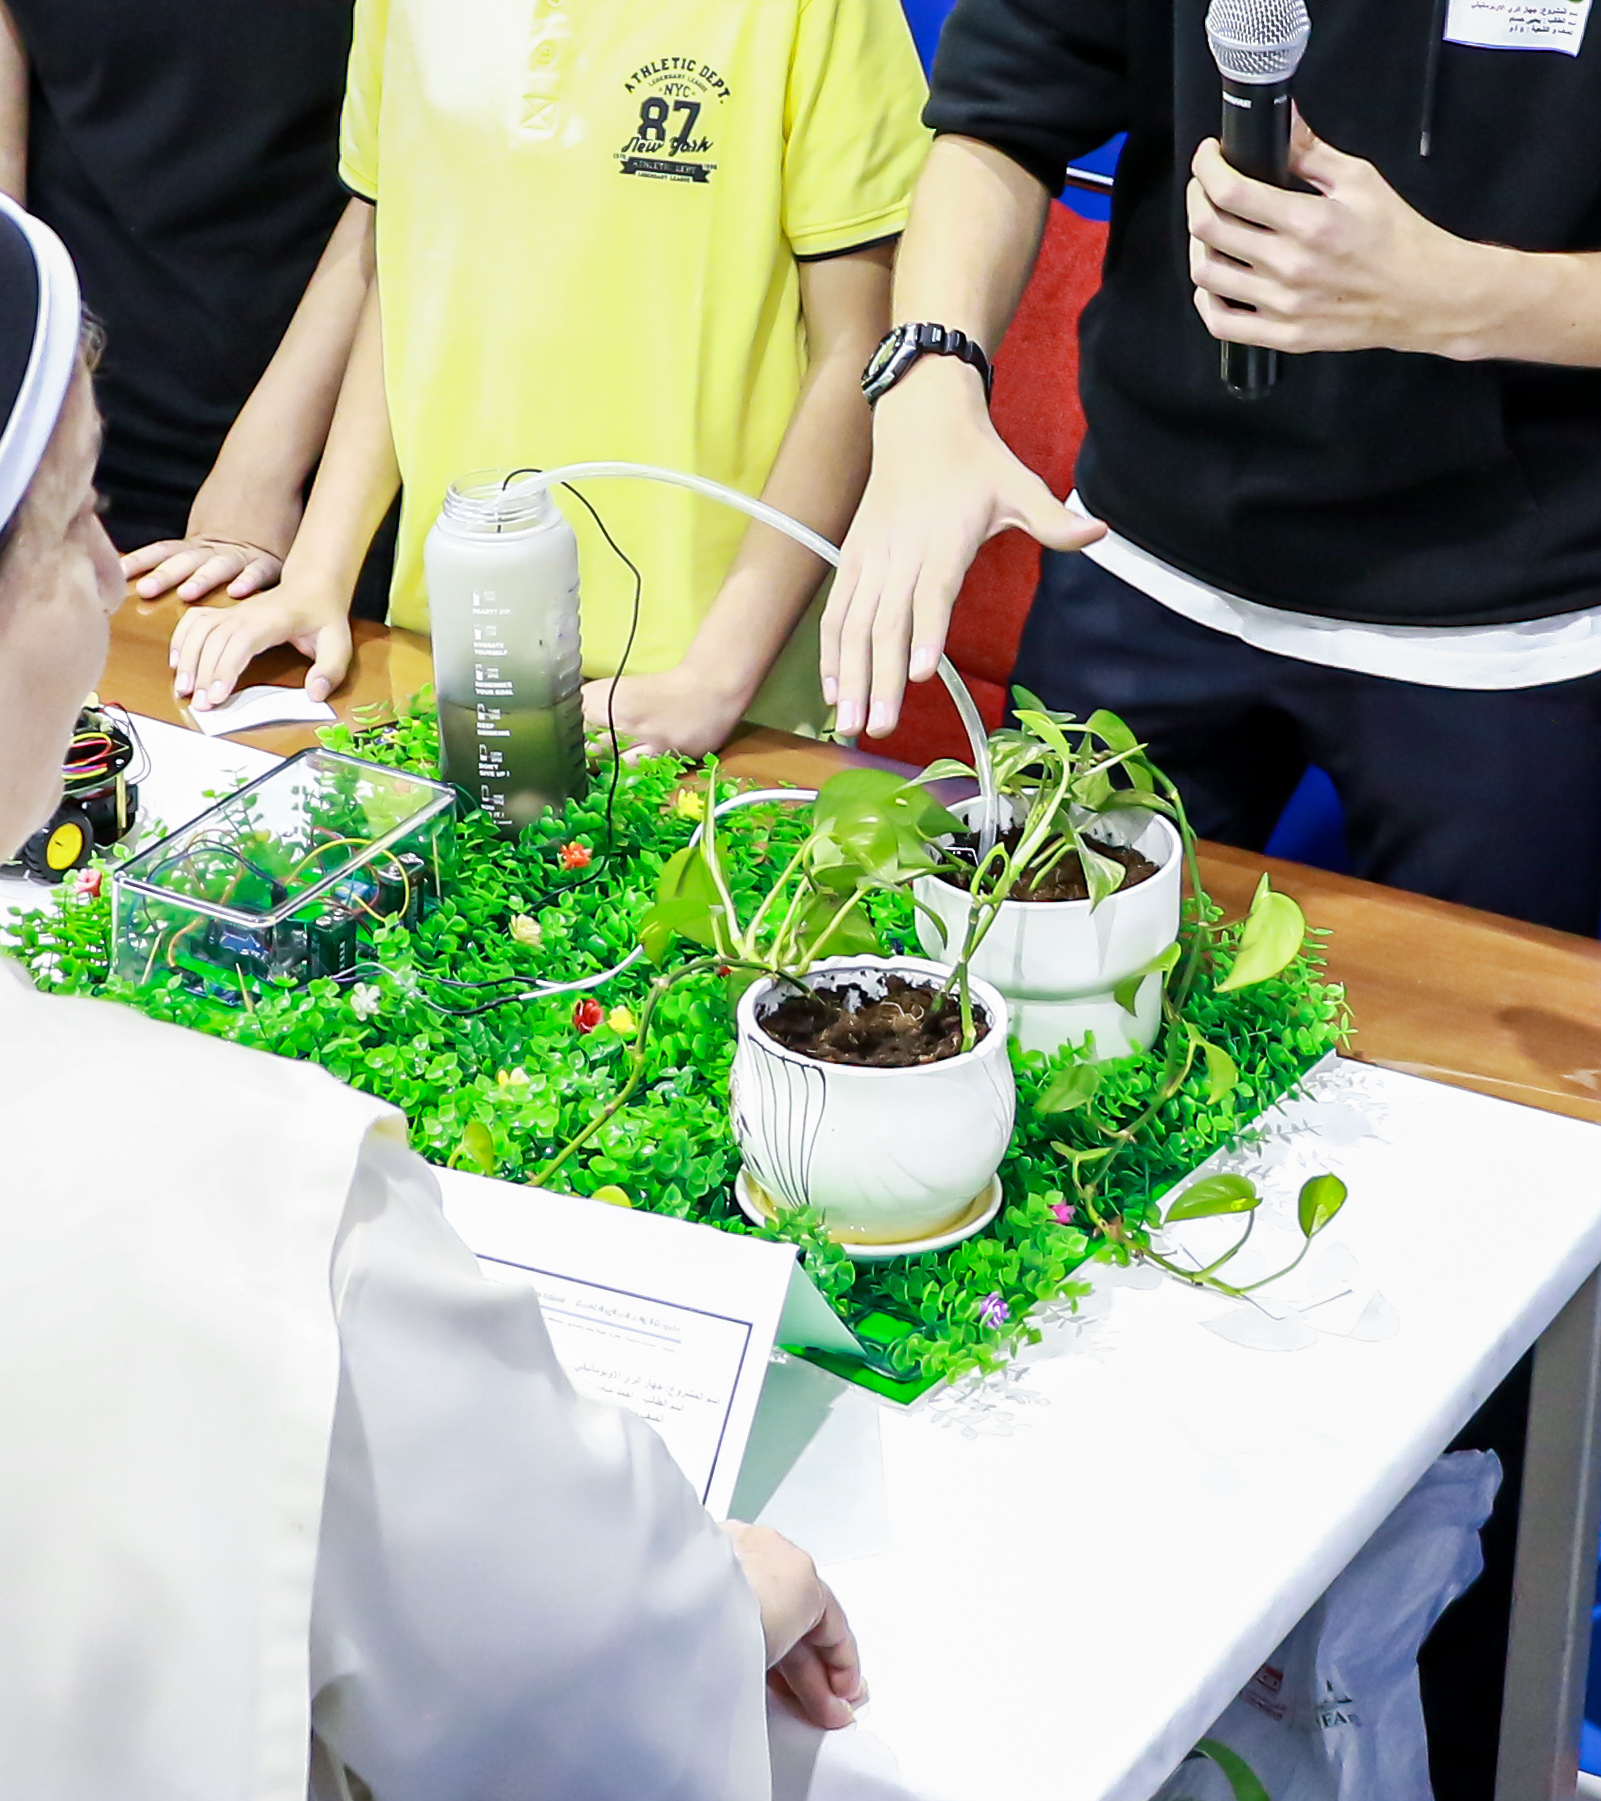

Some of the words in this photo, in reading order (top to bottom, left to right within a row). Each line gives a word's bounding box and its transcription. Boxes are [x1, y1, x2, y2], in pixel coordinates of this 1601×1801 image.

[624, 57, 697, 94] ATHLETIC
[663, 83, 691, 98] NYC
[637, 96, 702, 143] 87
[621, 134, 665, 153] New
